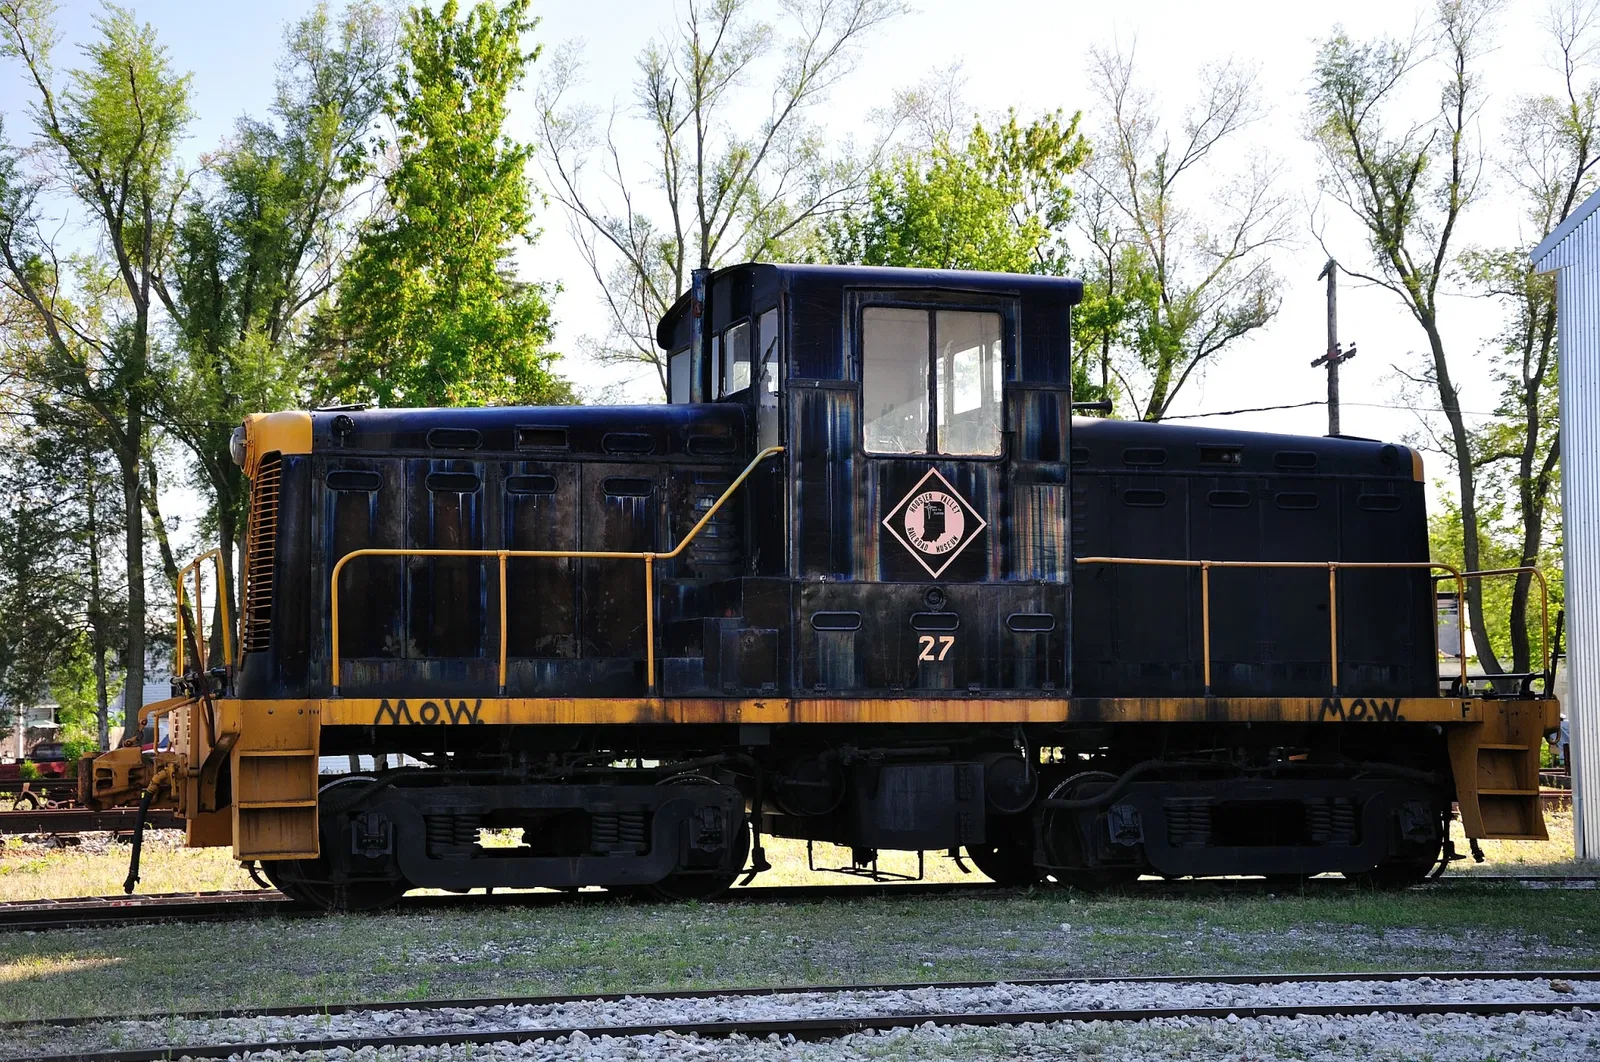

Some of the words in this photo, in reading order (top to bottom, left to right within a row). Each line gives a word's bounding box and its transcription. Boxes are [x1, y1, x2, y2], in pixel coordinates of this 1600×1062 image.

[909, 493, 933, 513] HOOSIER
[940, 494, 960, 514] VALLEY
[907, 527, 929, 552] RAILROAD
[935, 535, 959, 553] MUSEUM
[918, 635, 955, 661] 27
[374, 699, 484, 725] M.O.W.
[1461, 701, 1471, 718] F
